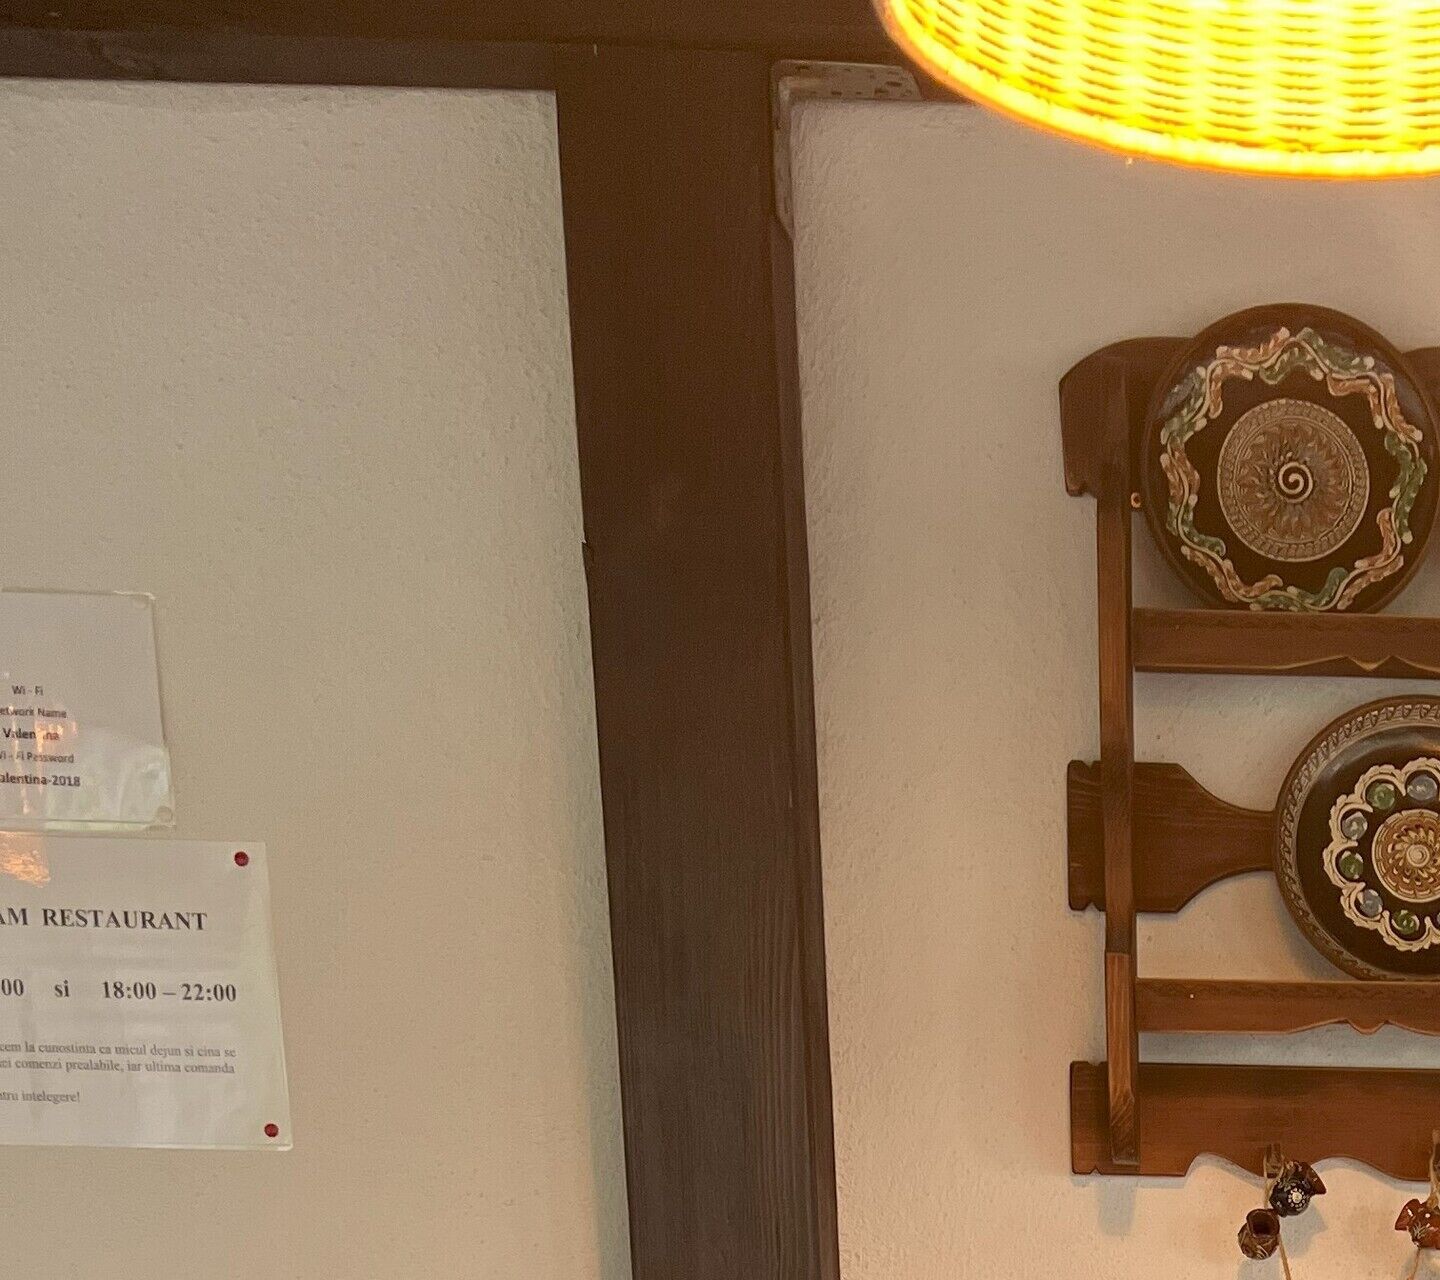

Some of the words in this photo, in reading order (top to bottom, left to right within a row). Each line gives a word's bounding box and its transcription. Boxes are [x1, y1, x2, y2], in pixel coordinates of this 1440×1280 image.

[12, 685, 25, 695] Wi
[35, 685, 44, 696] Fi
[37, 707, 67, 718] Name
[27, 752, 75, 764] Password
[42, 908, 208, 931] RESTAURANT
[54, 980, 70, 998] si
[103, 981, 157, 1000] 18:00
[180, 982, 237, 1001] 22:00
[25, 1041, 36, 1053] la
[39, 1044, 96, 1054] cunostinta
[99, 1045, 112, 1055] ca
[115, 1044, 147, 1056] micul
[150, 1044, 181, 1058] dejun
[184, 1046, 194, 1057] si
[197, 1047, 221, 1057] cina
[224, 1048, 236, 1057] se
[15, 1059, 62, 1069] comenzi
[66, 1060, 124, 1073] prealabile,
[127, 1061, 142, 1072] iar
[145, 1061, 181, 1072] ultima
[184, 1062, 236, 1074] comanda
[22, 1090, 80, 1104] intelegere!
